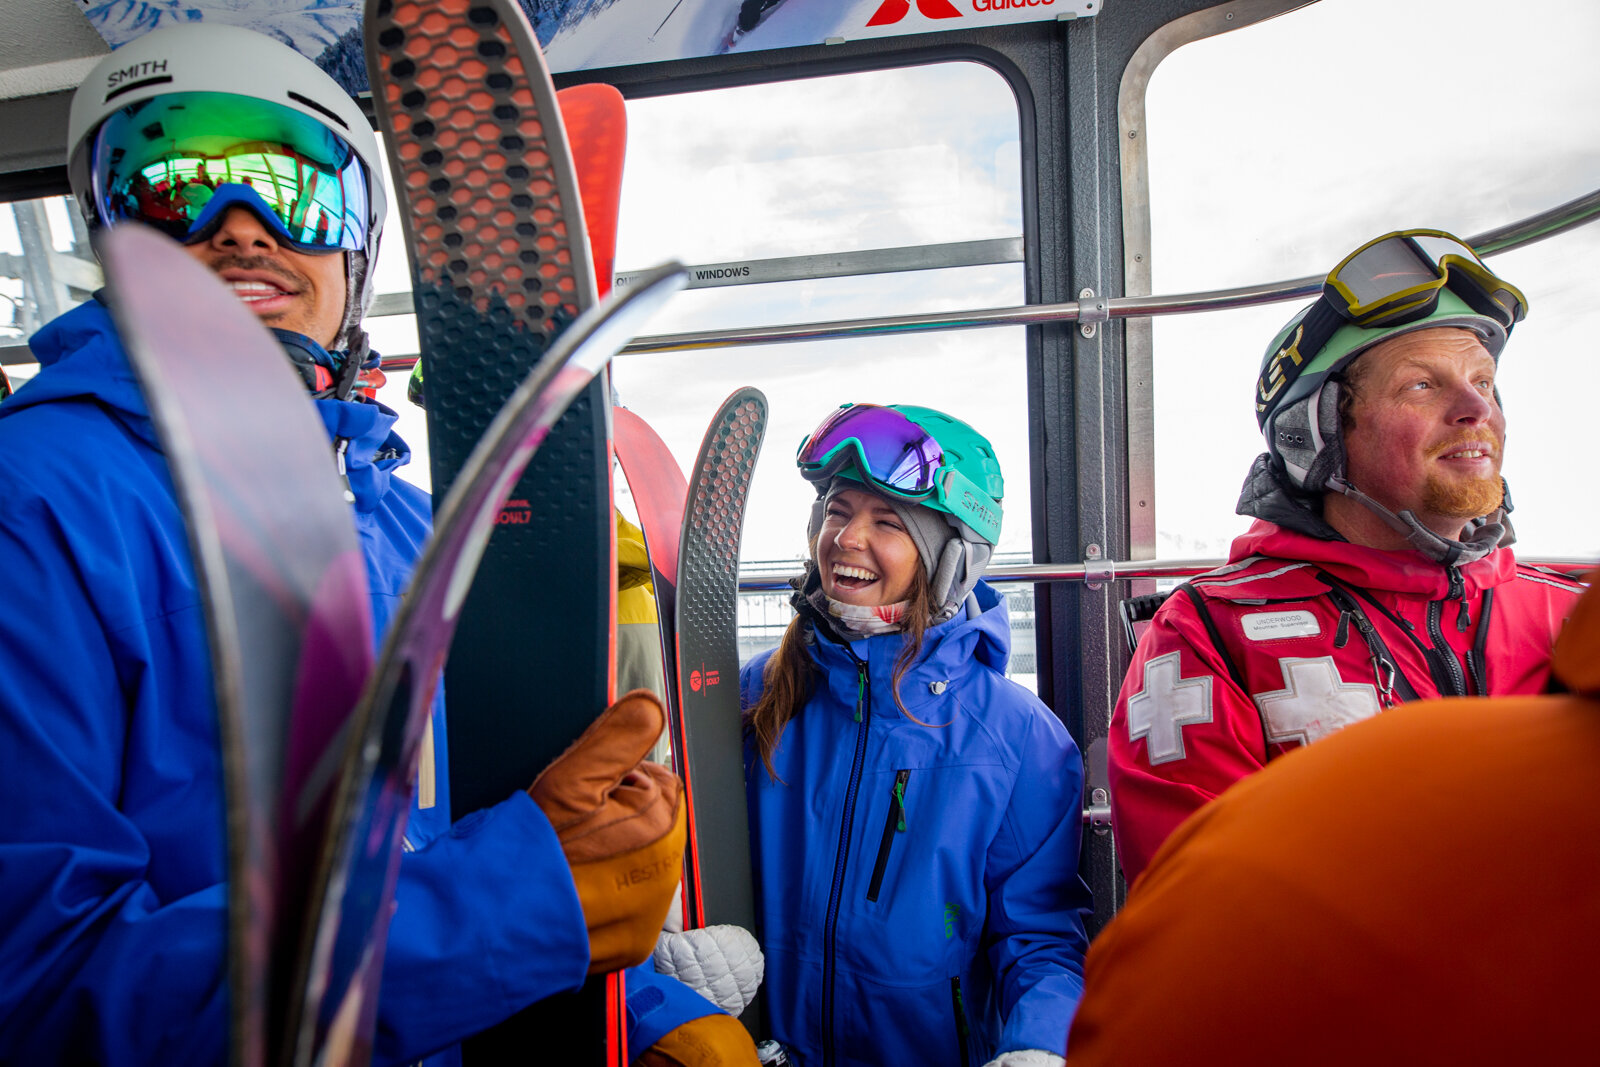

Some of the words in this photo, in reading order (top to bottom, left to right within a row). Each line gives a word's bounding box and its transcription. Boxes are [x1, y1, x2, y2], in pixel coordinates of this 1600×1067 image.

[107, 59, 168, 88] SMITH
[696, 267, 750, 280] WINDOWS
[961, 491, 999, 529] SMITH
[1256, 615, 1302, 625] UNDERWOOD
